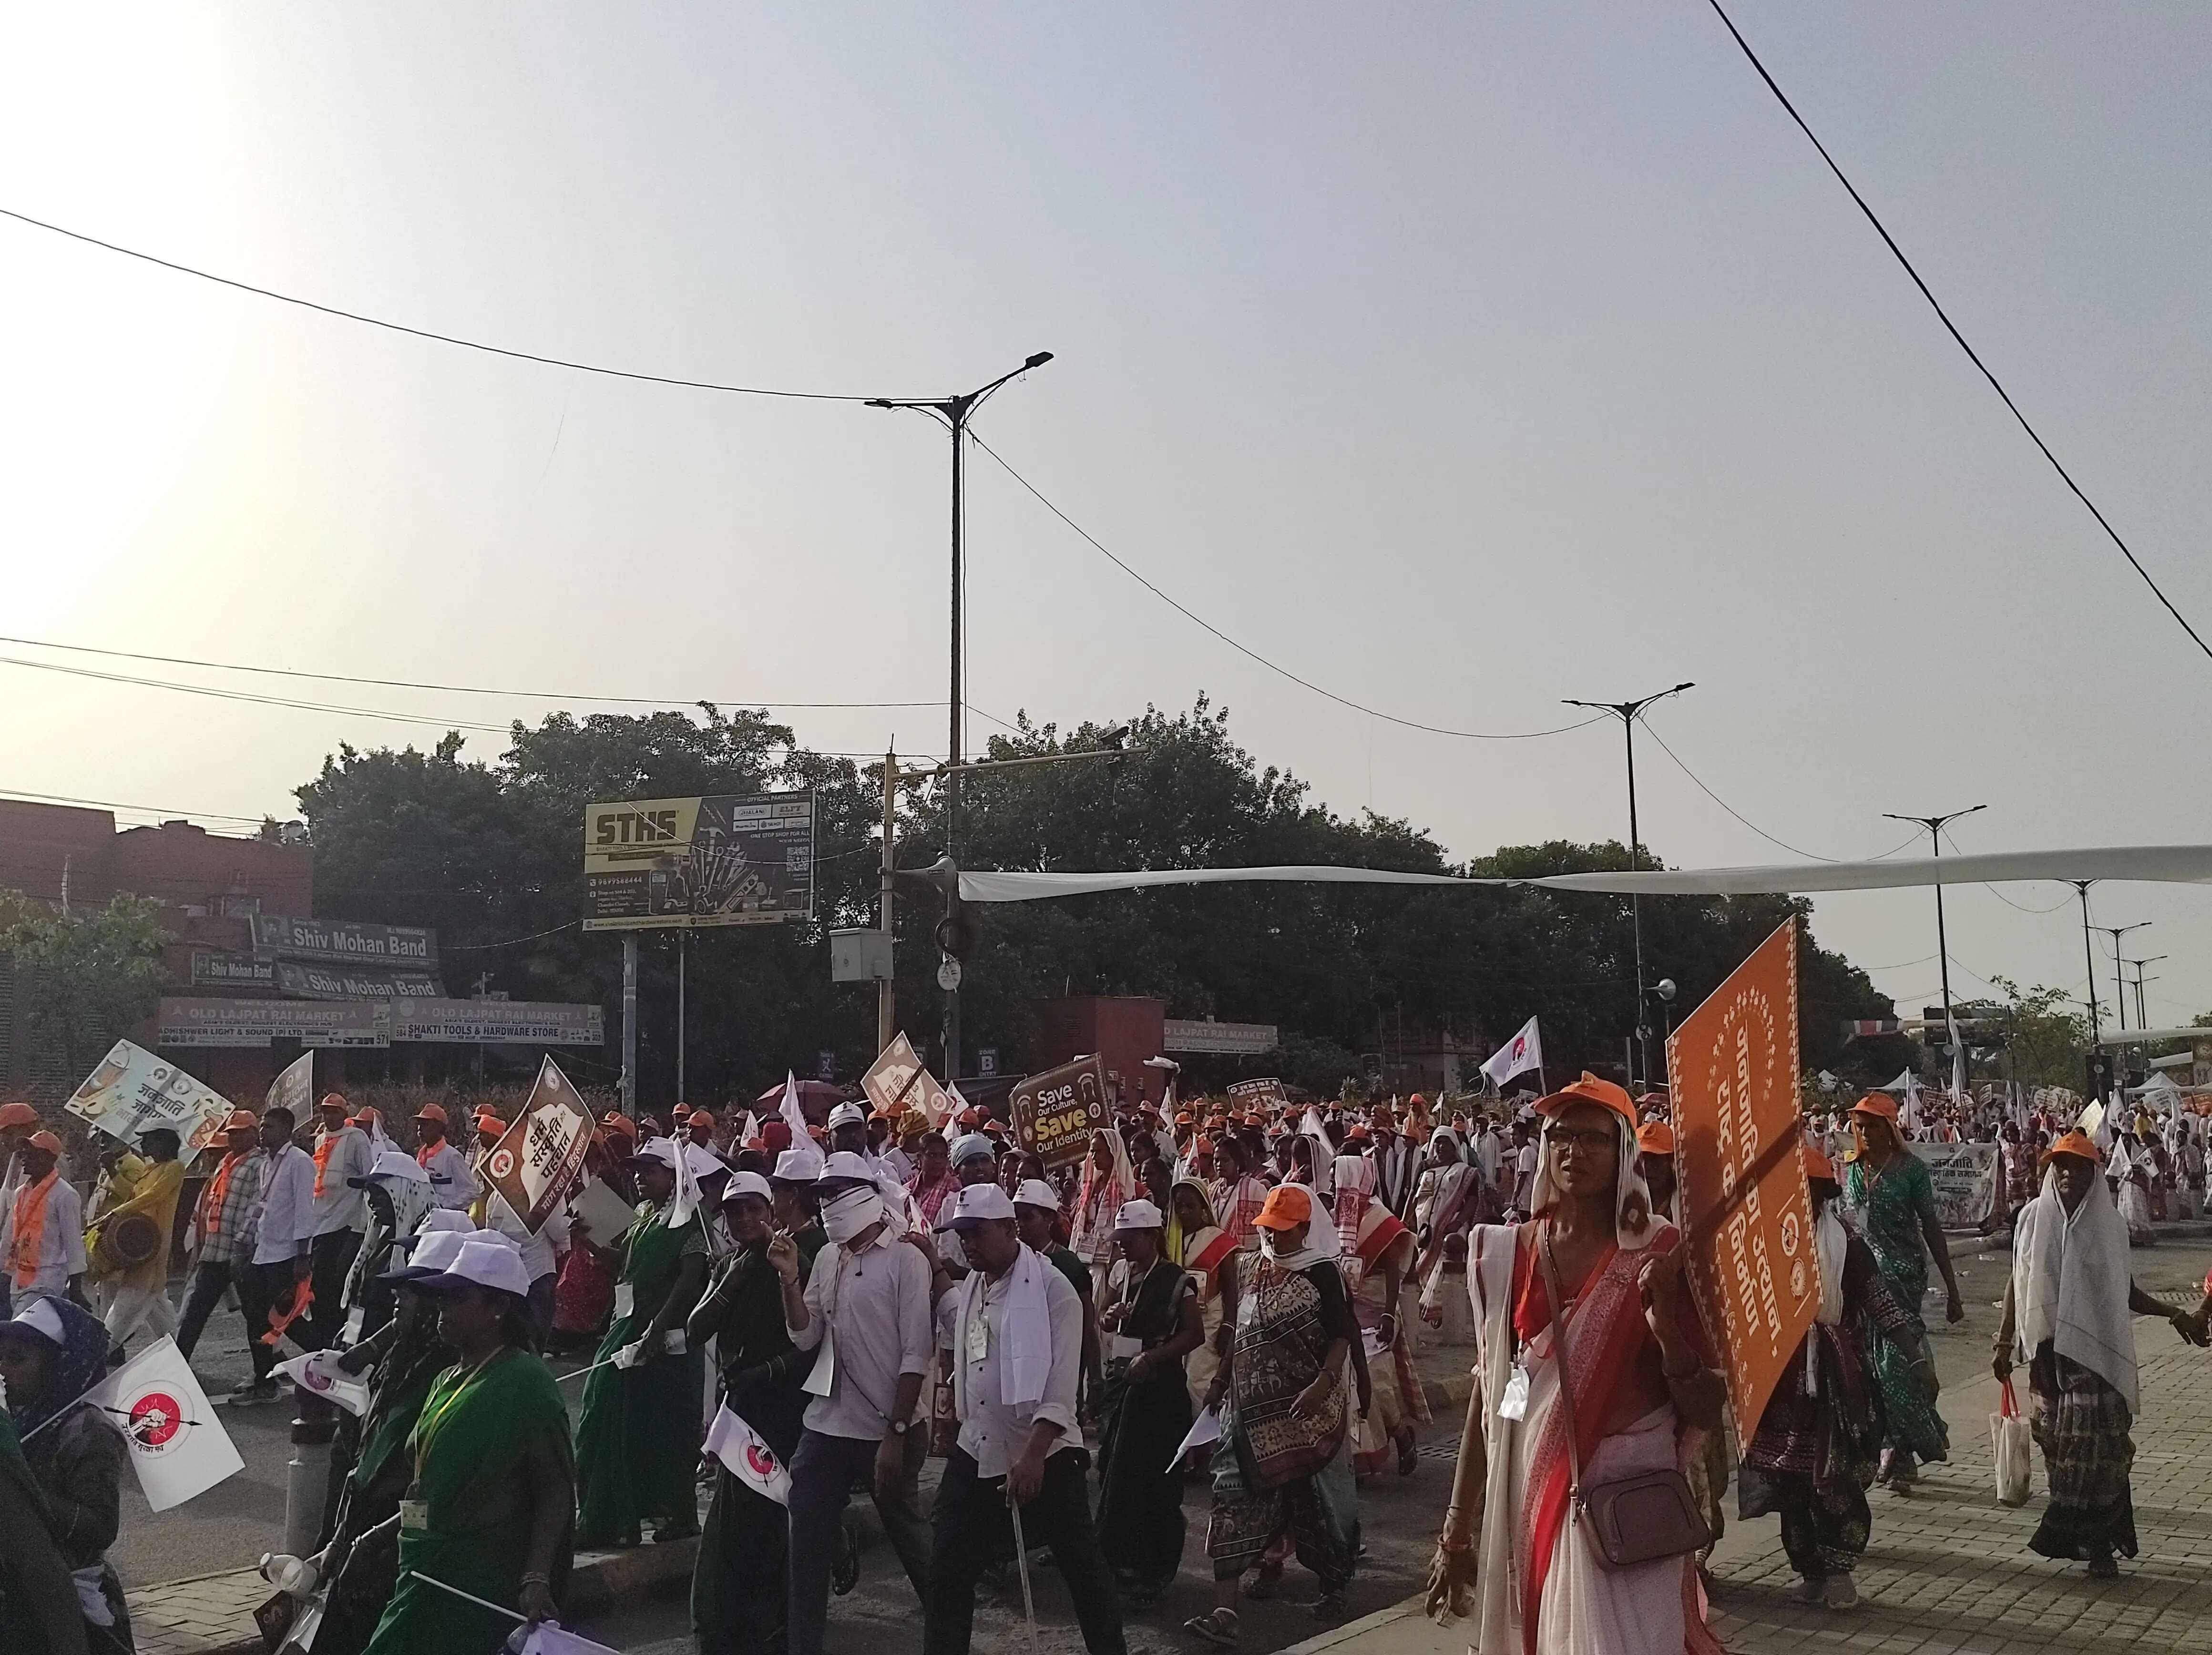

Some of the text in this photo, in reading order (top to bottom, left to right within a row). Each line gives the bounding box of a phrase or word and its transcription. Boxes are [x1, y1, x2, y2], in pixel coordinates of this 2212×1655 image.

[597, 810, 676, 844] STHS
[294, 928, 329, 949] Shiv
[333, 931, 385, 954] Mohan
[389, 936, 427, 957] Band
[211, 961, 272, 979] Shiv Mohan Band
[309, 974, 341, 993] Shiv
[343, 979, 395, 996] Mohan
[395, 981, 436, 996] Band
[189, 1008, 347, 1022] OLD LAJPAT RAI MARKET
[432, 1007, 572, 1021] OLD LAJPAT RAI MARKET
[377, 1034, 389, 1045] 571
[408, 1024, 440, 1034] SHAKTI
[444, 1026, 471, 1035] TOOLS
[474, 1026, 481, 1035] &
[483, 1026, 530, 1036] HARDWARE
[532, 1028, 558, 1037] STORE
[1173, 1028, 1208, 1037] LAJPAT
[1211, 1030, 1228, 1038] RAI
[1231, 1031, 1267, 1039] MARKET
[982, 1056, 993, 1071] B
[138, 1083, 185, 1116] जनजाति
[1037, 1085, 1072, 1107] Save
[1736, 1019, 1759, 1170] जनजाति
[1038, 1099, 1077, 1116] Our Culture,
[530, 1117, 547, 1147] धर्म
[1035, 1109, 1087, 1140] Save
[530, 1117, 562, 1167] संस्कृति
[1036, 1127, 1092, 1153] Our Identity
[541, 1131, 570, 1178] पहचान
[1931, 1156, 1974, 1168] जनजाति
[553, 1174, 566, 1191] रहा
[1717, 1073, 1761, 1337] राष्ट्र का निर्माण
[1745, 1171, 1762, 1226] का
